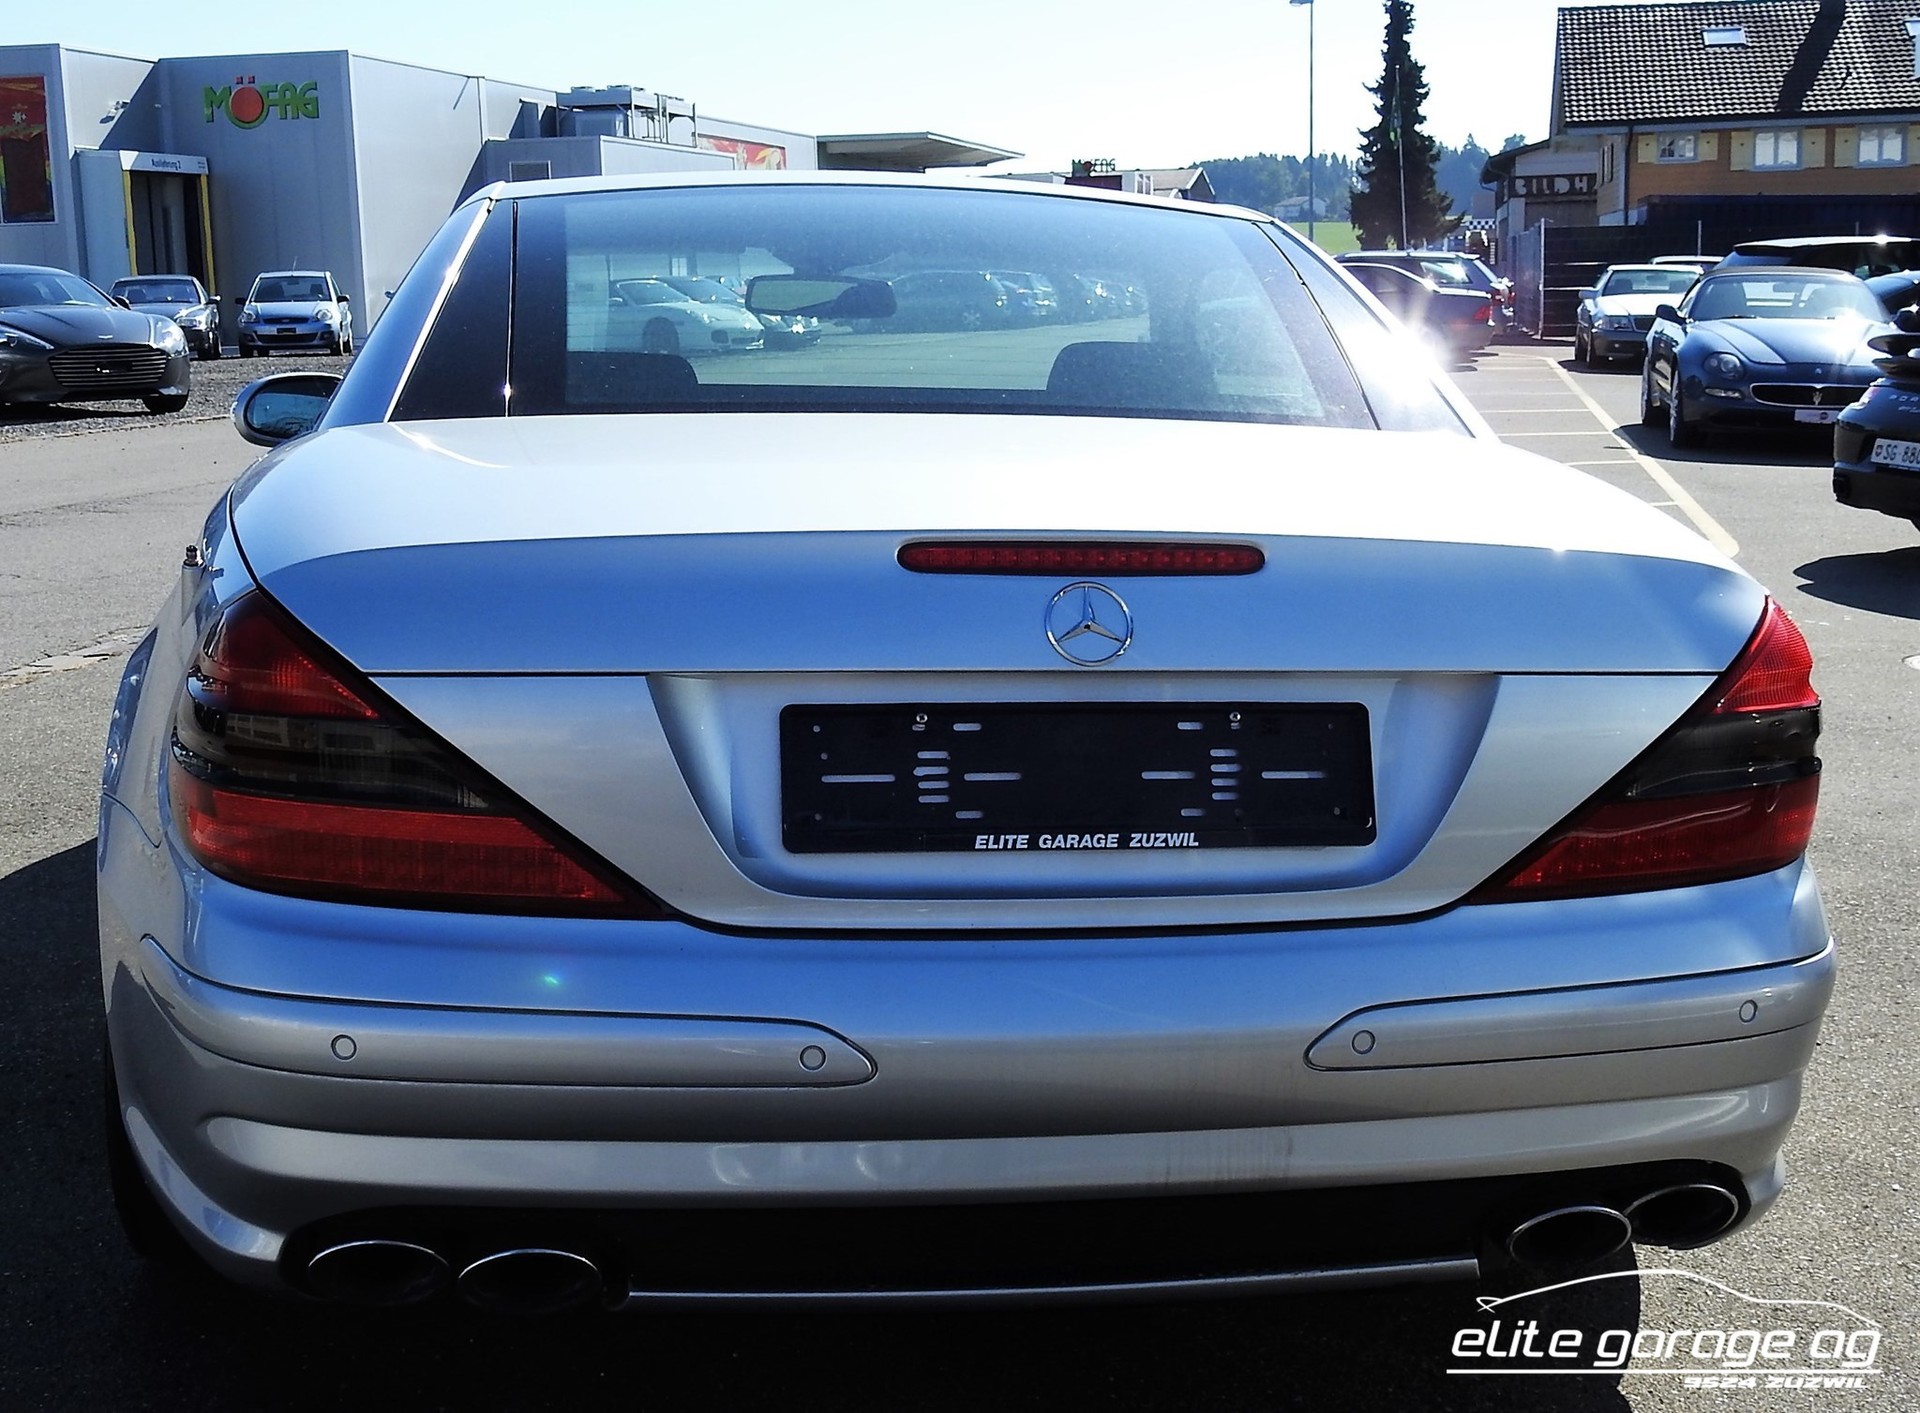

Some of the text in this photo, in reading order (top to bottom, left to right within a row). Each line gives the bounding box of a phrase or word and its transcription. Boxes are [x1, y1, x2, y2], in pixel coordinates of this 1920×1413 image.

[203, 76, 320, 130] MÖFAG
[1514, 175, 1598, 195] BILDH
[1883, 444, 1898, 461] SG
[975, 832, 1200, 849] ELITE GARAGE ZUZWIL
